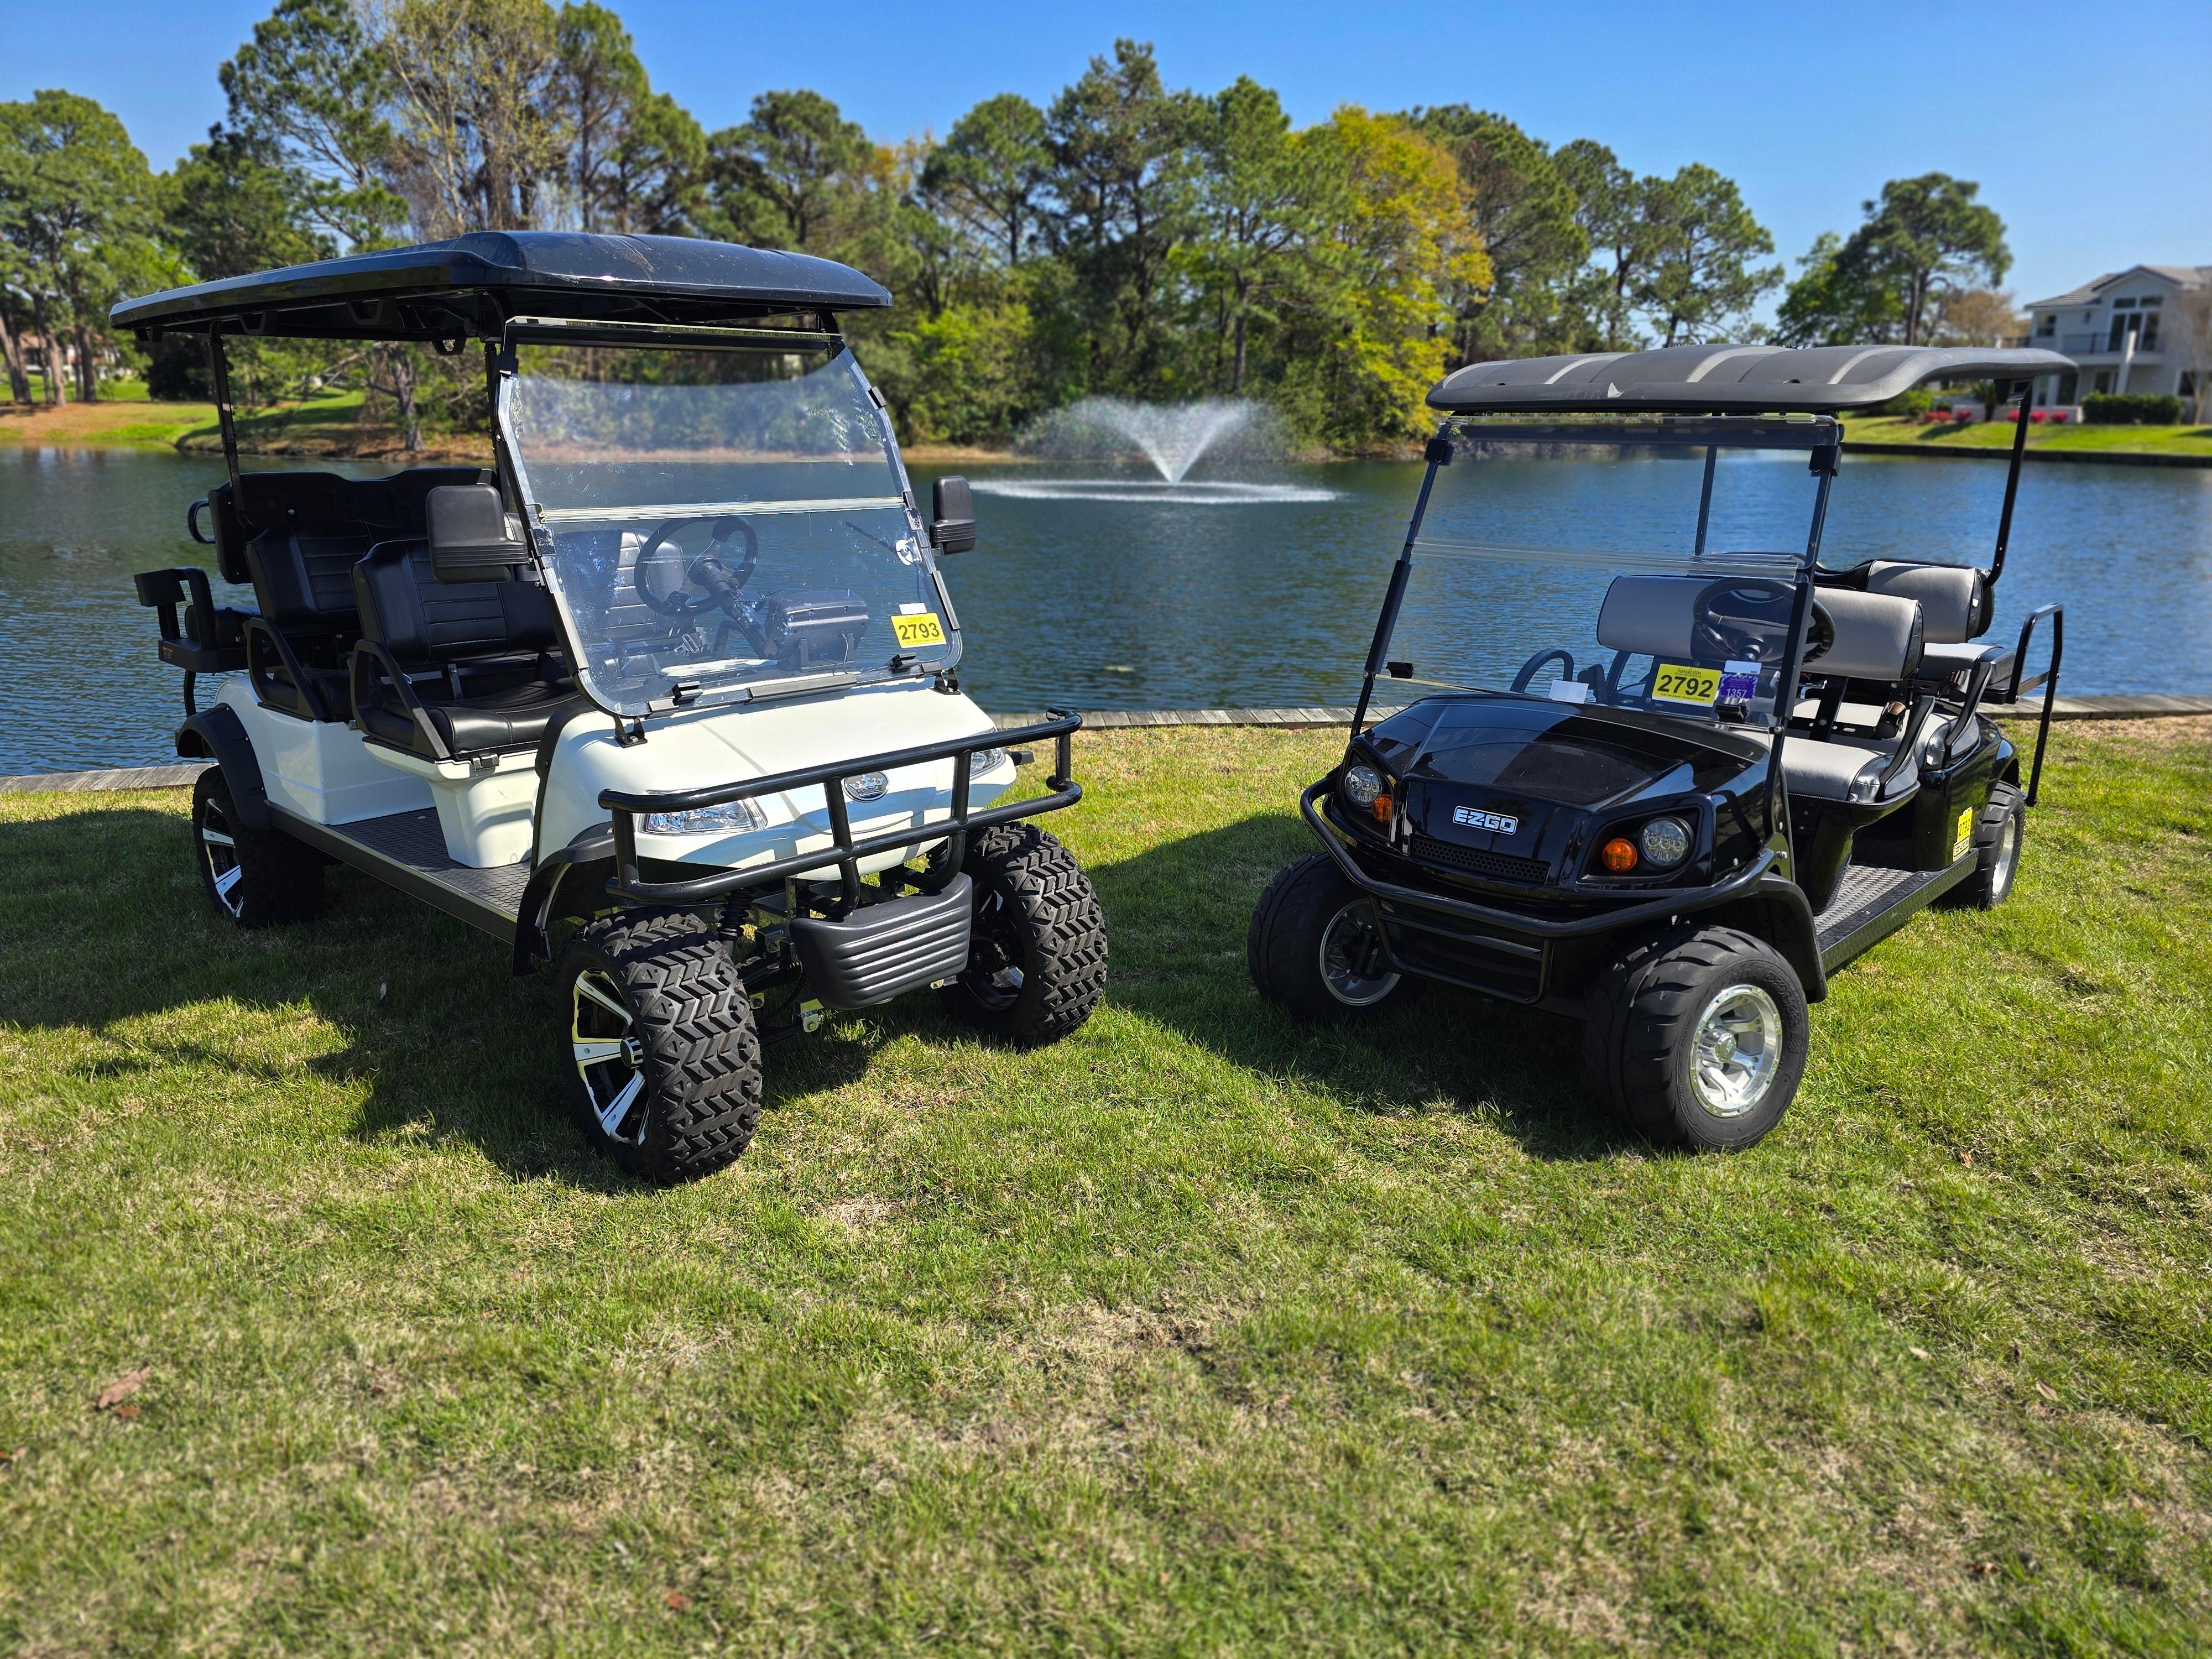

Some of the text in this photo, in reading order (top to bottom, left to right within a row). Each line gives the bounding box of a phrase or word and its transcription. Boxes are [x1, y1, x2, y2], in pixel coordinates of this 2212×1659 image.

[899, 622, 940, 640] 2793
[1657, 674, 1713, 698] 2792
[1726, 687, 1747, 698] 1357
[1454, 808, 1516, 833] EZGO
